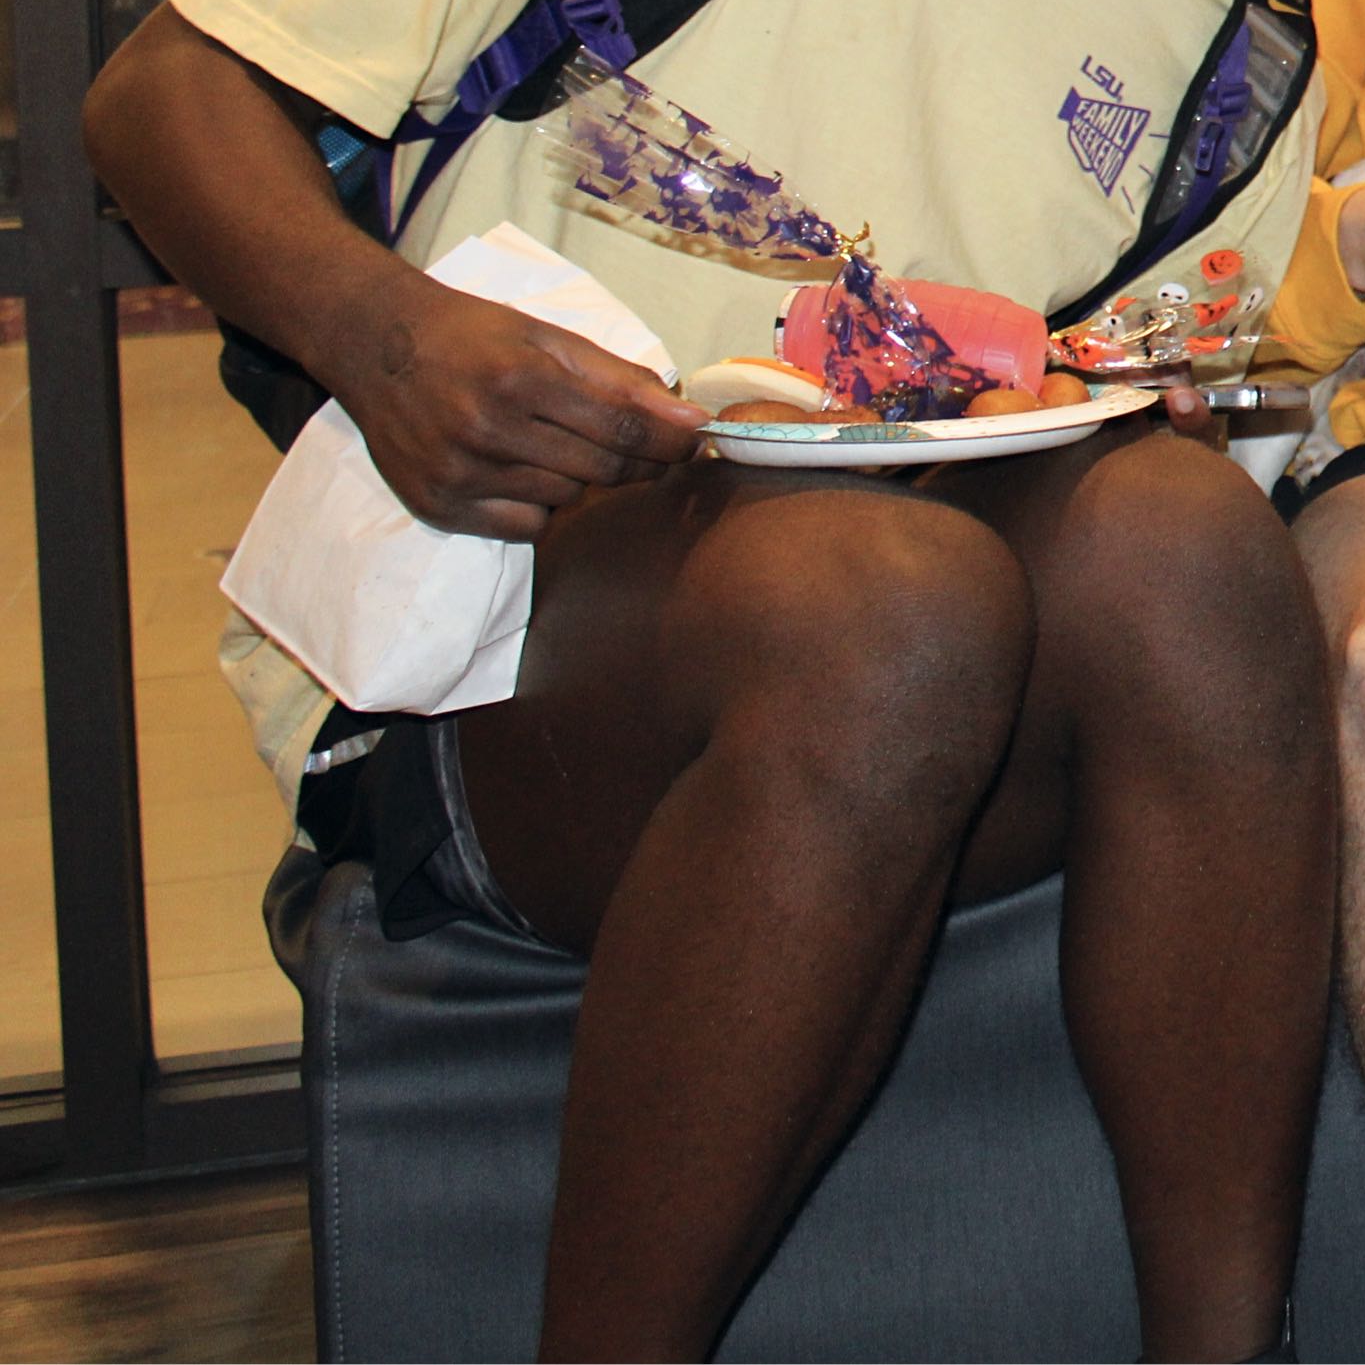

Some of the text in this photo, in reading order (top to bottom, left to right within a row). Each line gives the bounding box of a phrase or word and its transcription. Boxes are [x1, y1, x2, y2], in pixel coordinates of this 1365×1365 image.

[1080, 54, 1124, 98] LSU
[1076, 99, 1149, 151] FAMILY
[1071, 116, 1125, 190] WEEKEND
